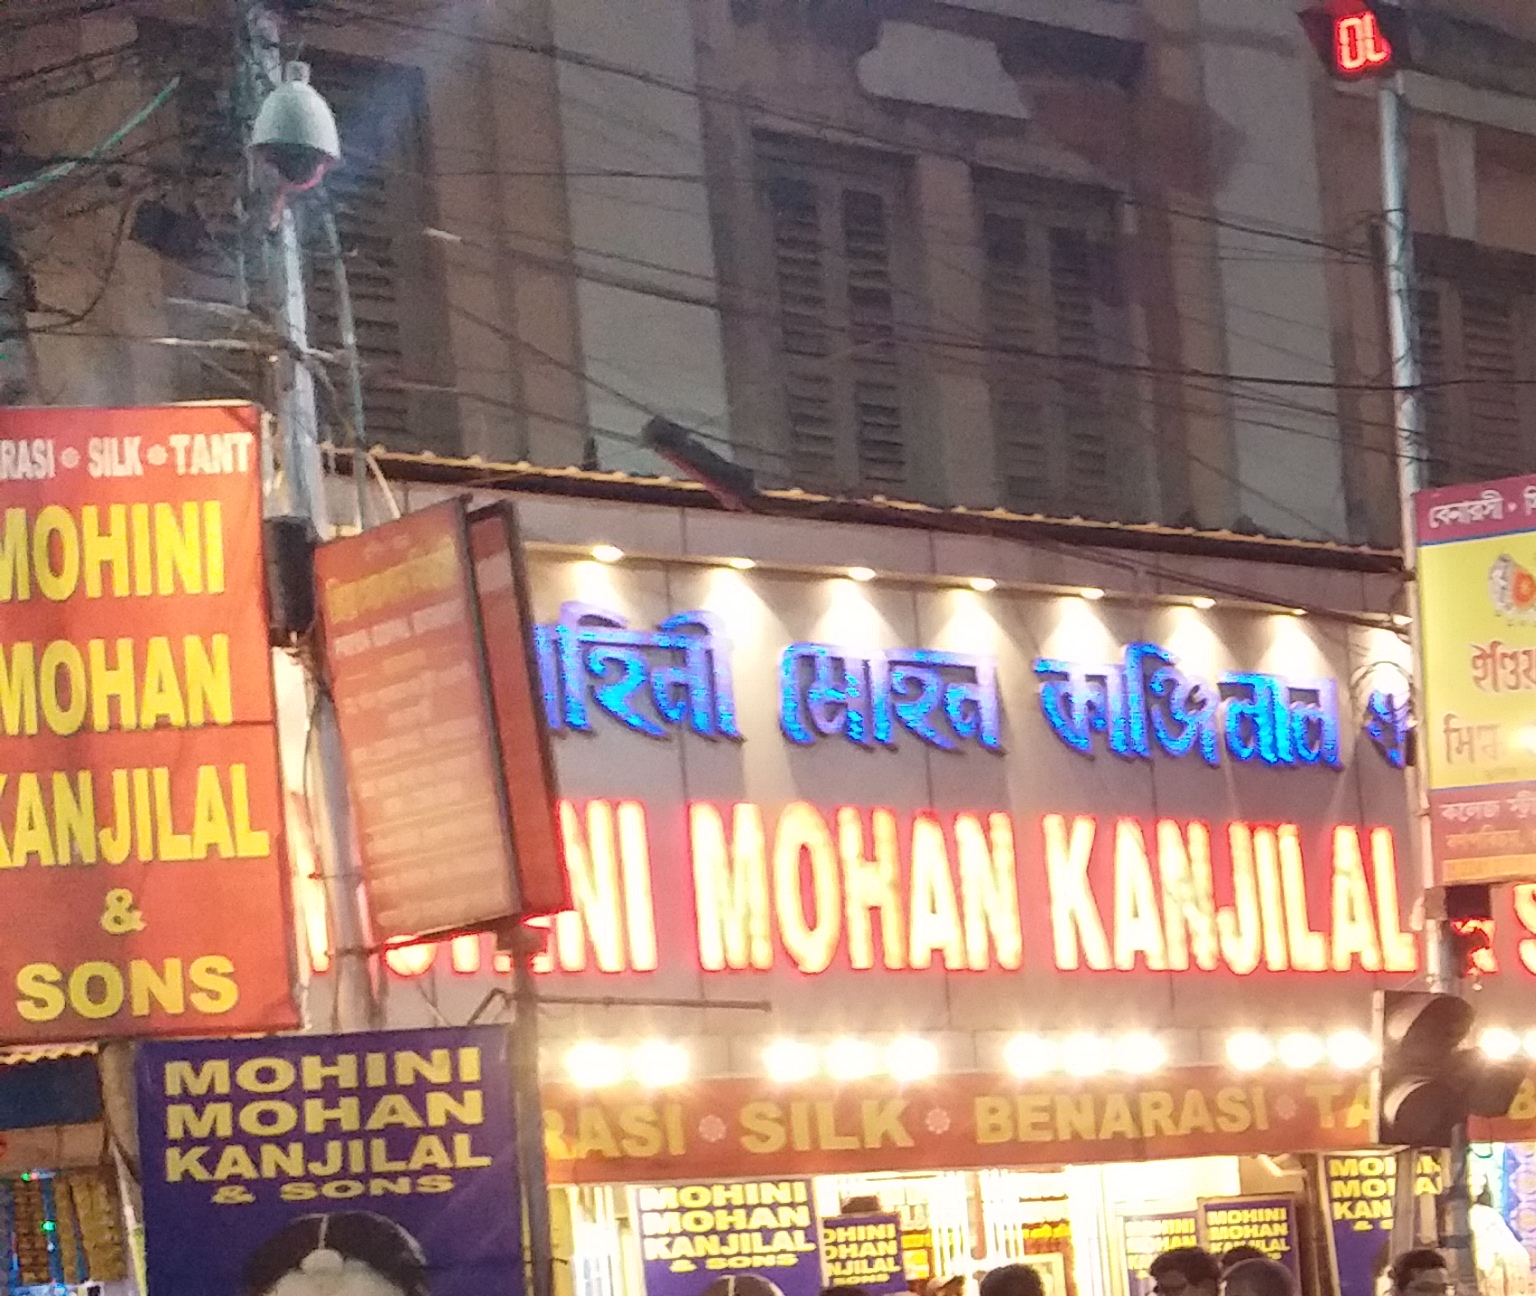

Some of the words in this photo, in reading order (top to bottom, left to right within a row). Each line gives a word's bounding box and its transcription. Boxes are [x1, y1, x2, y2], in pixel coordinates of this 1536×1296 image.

[88, 435, 144, 478] SILK
[169, 432, 254, 475] TANT
[0, 633, 234, 737] MOHAN
[689, 799, 1023, 974] MOHAN
[1042, 813, 1418, 975] KANJILAL
[100, 887, 146, 935] &
[16, 954, 239, 1022] SONS
[164, 1046, 482, 1097] MOHINI
[166, 1089, 485, 1140] MOHAN
[739, 1098, 917, 1151] SILK
[973, 1086, 1269, 1144] BENARASI
[165, 1132, 493, 1183] KANJILAL
[211, 1184, 257, 1205] &
[279, 1174, 456, 1201] SONS
[639, 1181, 808, 1211] MOHINI
[642, 1206, 811, 1236] MOHAN
[1207, 1207, 1288, 1226] MOHINI
[1209, 1222, 1289, 1241] MOHAN
[644, 1230, 817, 1261] KANJILAL
[823, 1223, 897, 1244] OHINI
[670, 1259, 697, 1273] &
[705, 1252, 799, 1271] SONS
[824, 1240, 898, 1260] OHAN
[828, 1256, 902, 1277] NJILAL
